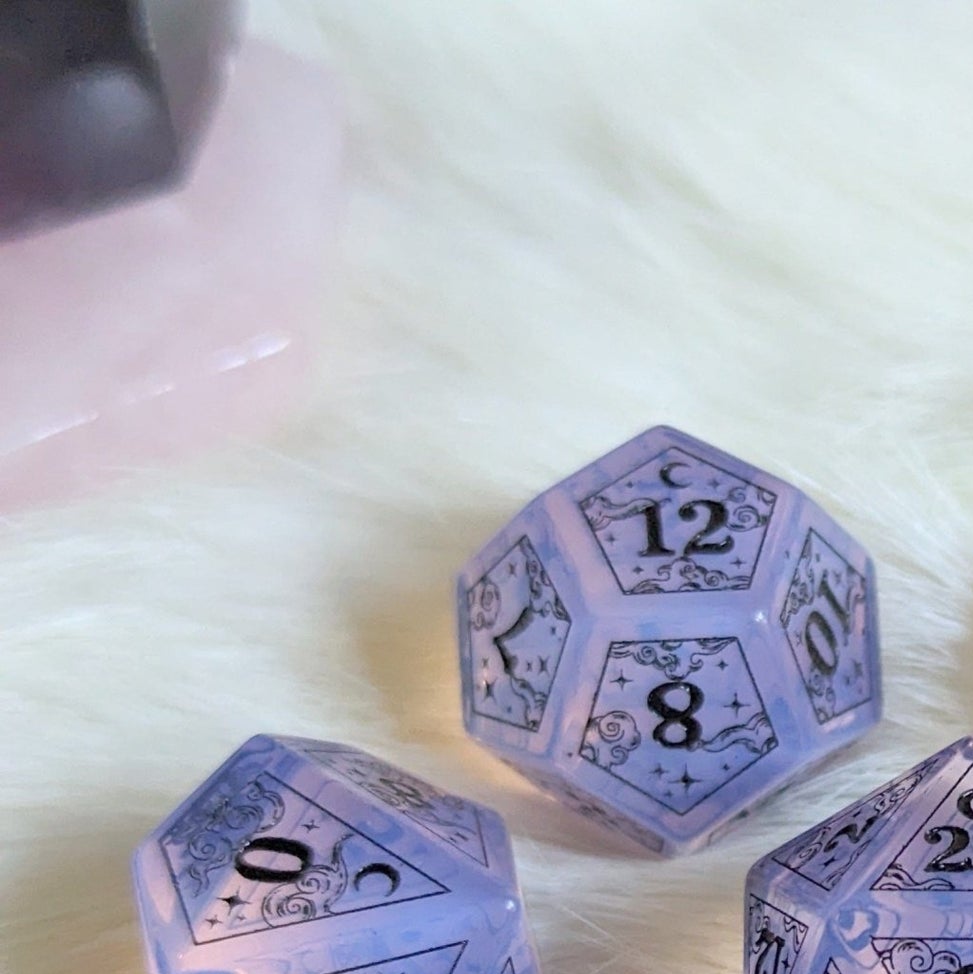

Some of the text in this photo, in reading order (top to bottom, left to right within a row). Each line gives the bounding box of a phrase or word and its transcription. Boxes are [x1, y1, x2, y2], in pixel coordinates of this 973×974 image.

[636, 499, 735, 558] 12
[804, 569, 851, 676] 10
[647, 681, 705, 750] 8
[235, 836, 314, 883] 0
